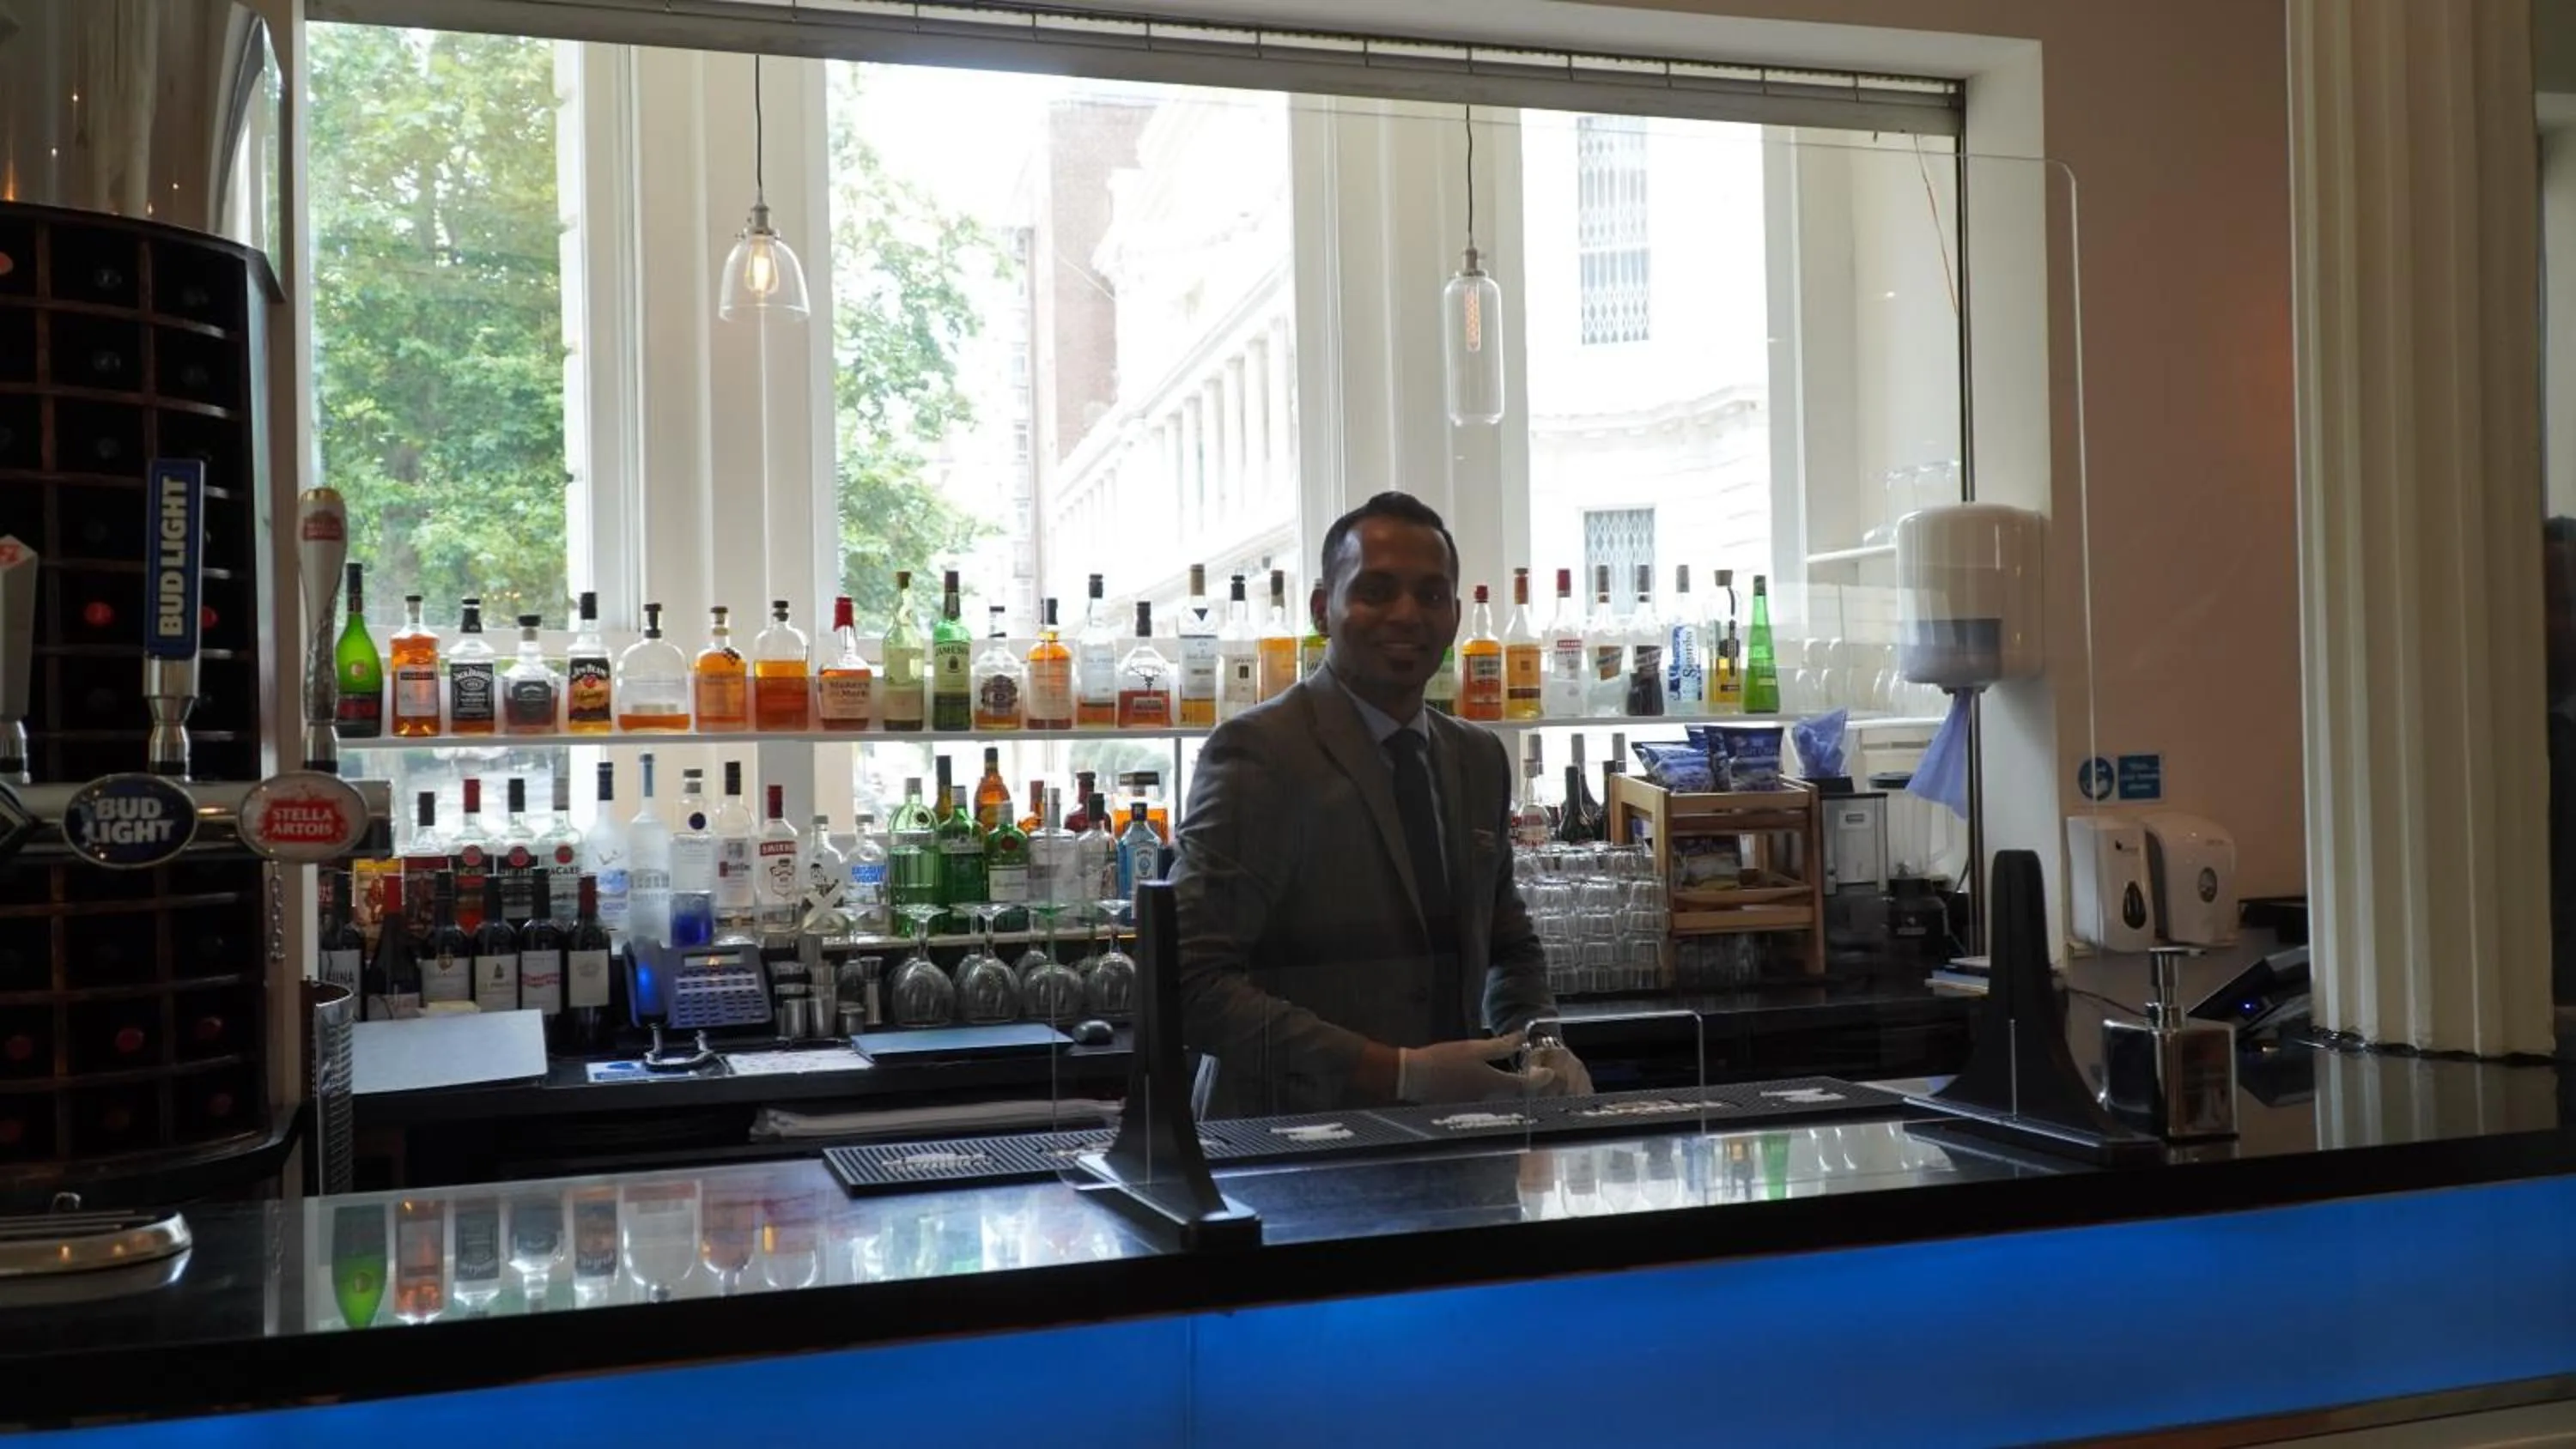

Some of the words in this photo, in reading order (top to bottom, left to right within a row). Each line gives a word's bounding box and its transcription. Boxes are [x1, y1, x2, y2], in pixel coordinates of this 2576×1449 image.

[160, 476, 187, 567] LIGHT
[158, 570, 185, 636] BUD
[95, 797, 163, 819] BUD
[272, 807, 334, 822] STELLA
[88, 819, 175, 845] LIGHT
[270, 822, 334, 836] ARTOIS
